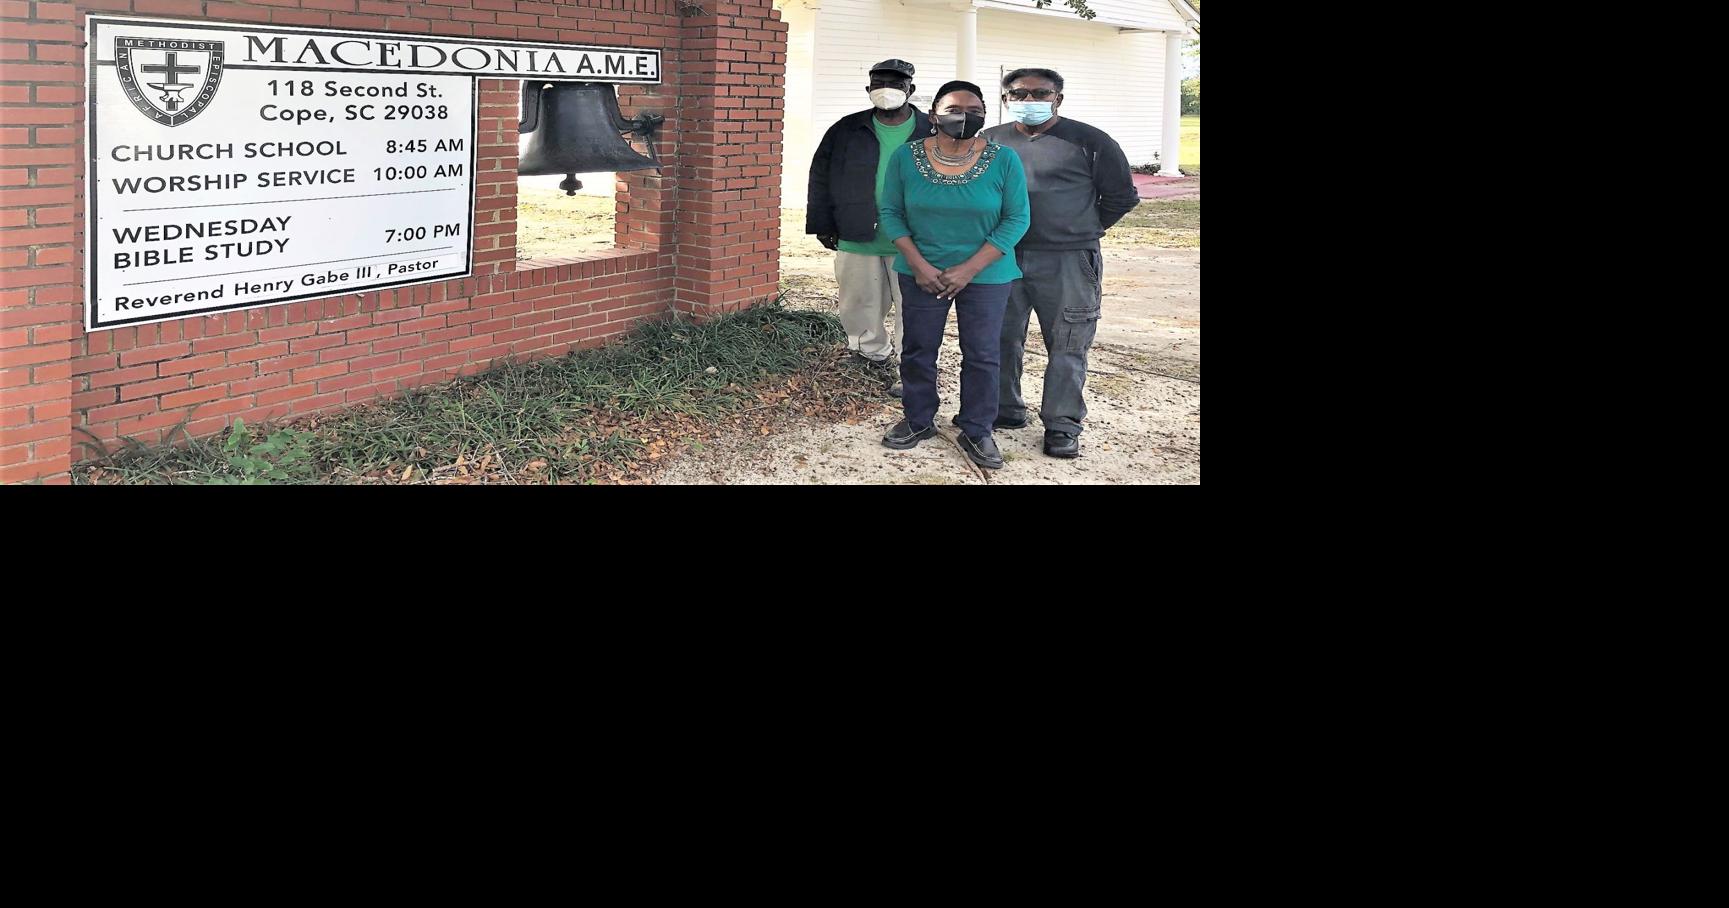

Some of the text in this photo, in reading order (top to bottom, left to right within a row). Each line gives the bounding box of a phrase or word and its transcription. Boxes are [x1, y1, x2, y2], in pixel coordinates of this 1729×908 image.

[124, 39, 216, 50] METHODIST
[243, 35, 655, 76] MACEDONIA A.M.E.
[118, 52, 163, 119] AFRICAN
[181, 56, 221, 119] EPISCOPAL
[267, 80, 443, 98] 118 Second St.
[260, 104, 448, 125] Cope, SC 29038
[111, 141, 347, 162] CHURCH SCHOOL
[386, 138, 464, 154] 8:45 AM
[112, 168, 355, 194] WORSHIP SERVICE
[373, 164, 463, 181] 10:00 AM
[112, 216, 292, 244] WEDNESDAY
[385, 223, 460, 243] 7:00 PM
[114, 238, 290, 269] BIBLE STUDY
[115, 284, 224, 311] Reverend
[234, 279, 294, 296] Henry
[301, 270, 350, 287] Gabe
[388, 259, 439, 275] Pastor
